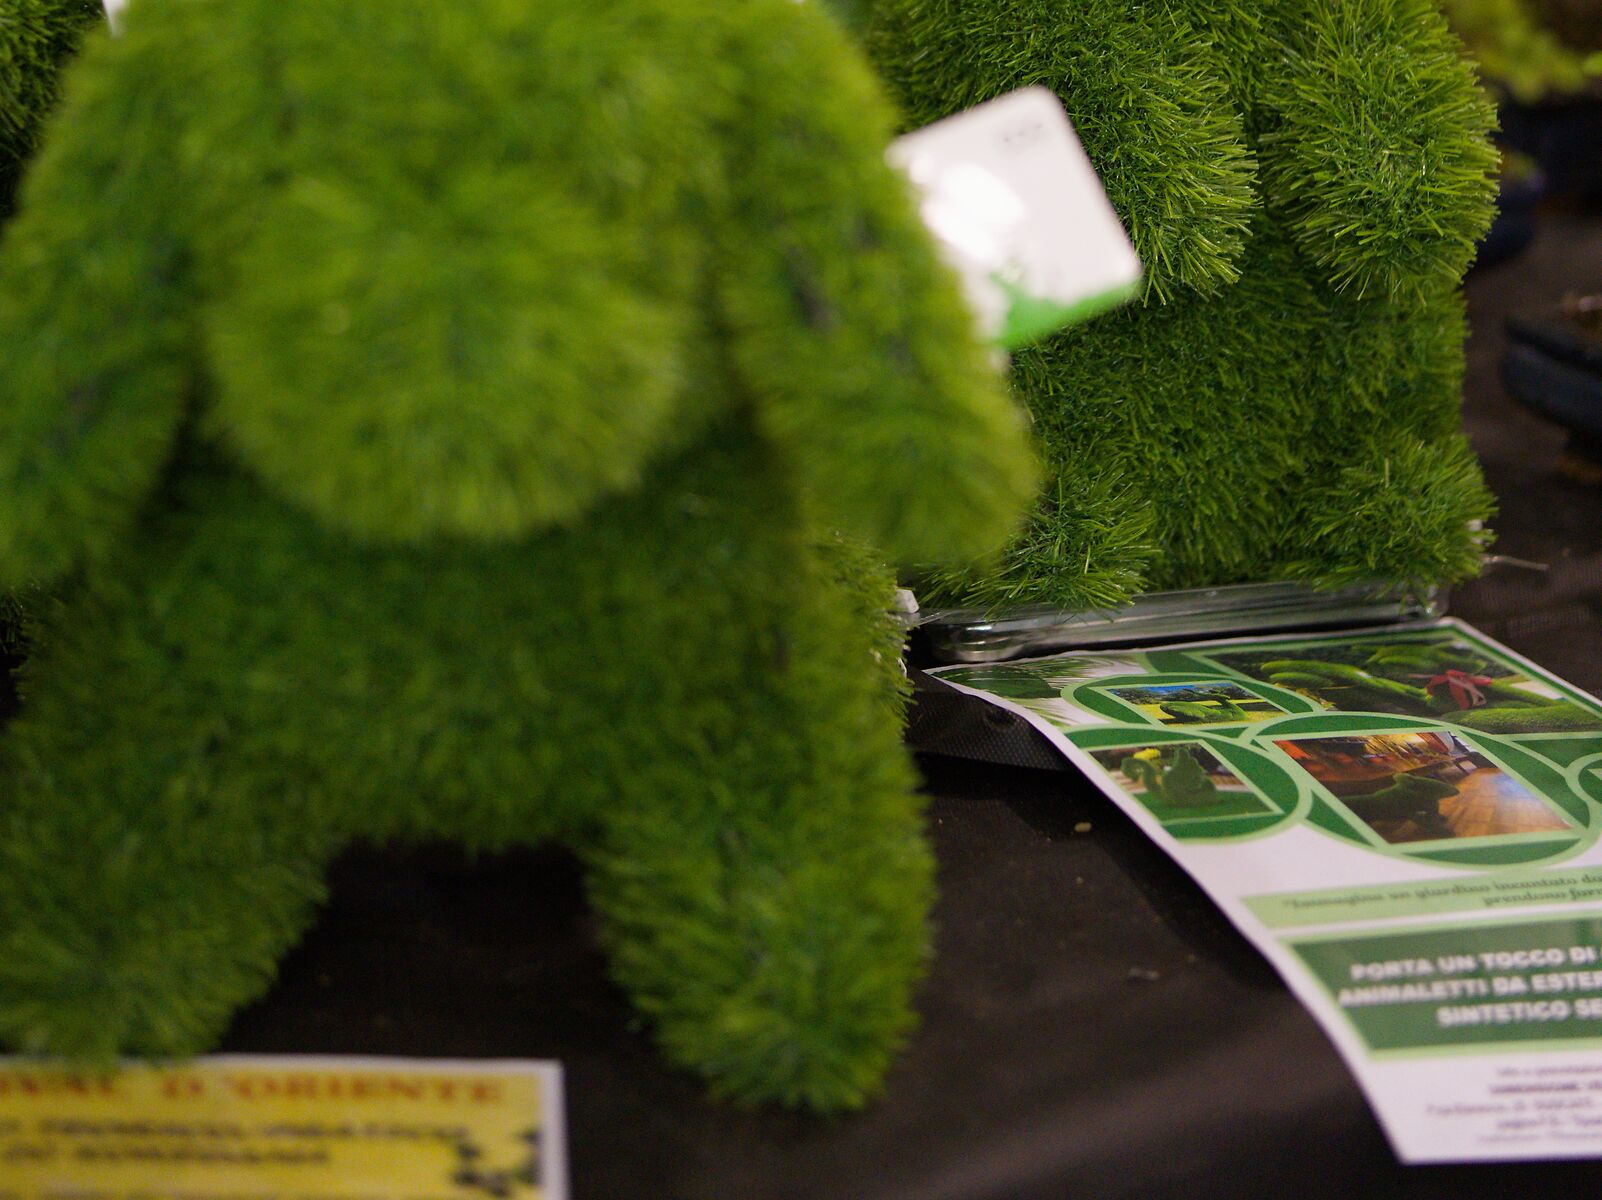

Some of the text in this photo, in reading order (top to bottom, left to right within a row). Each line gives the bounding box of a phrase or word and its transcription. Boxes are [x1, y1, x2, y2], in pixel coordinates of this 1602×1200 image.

[1351, 946, 1597, 981] PORTA UN TOCCO DI
[1338, 977, 1487, 1008] ANIMALETTI
[1491, 975, 1528, 997] DA
[1436, 1000, 1571, 1028] SINTETICO
